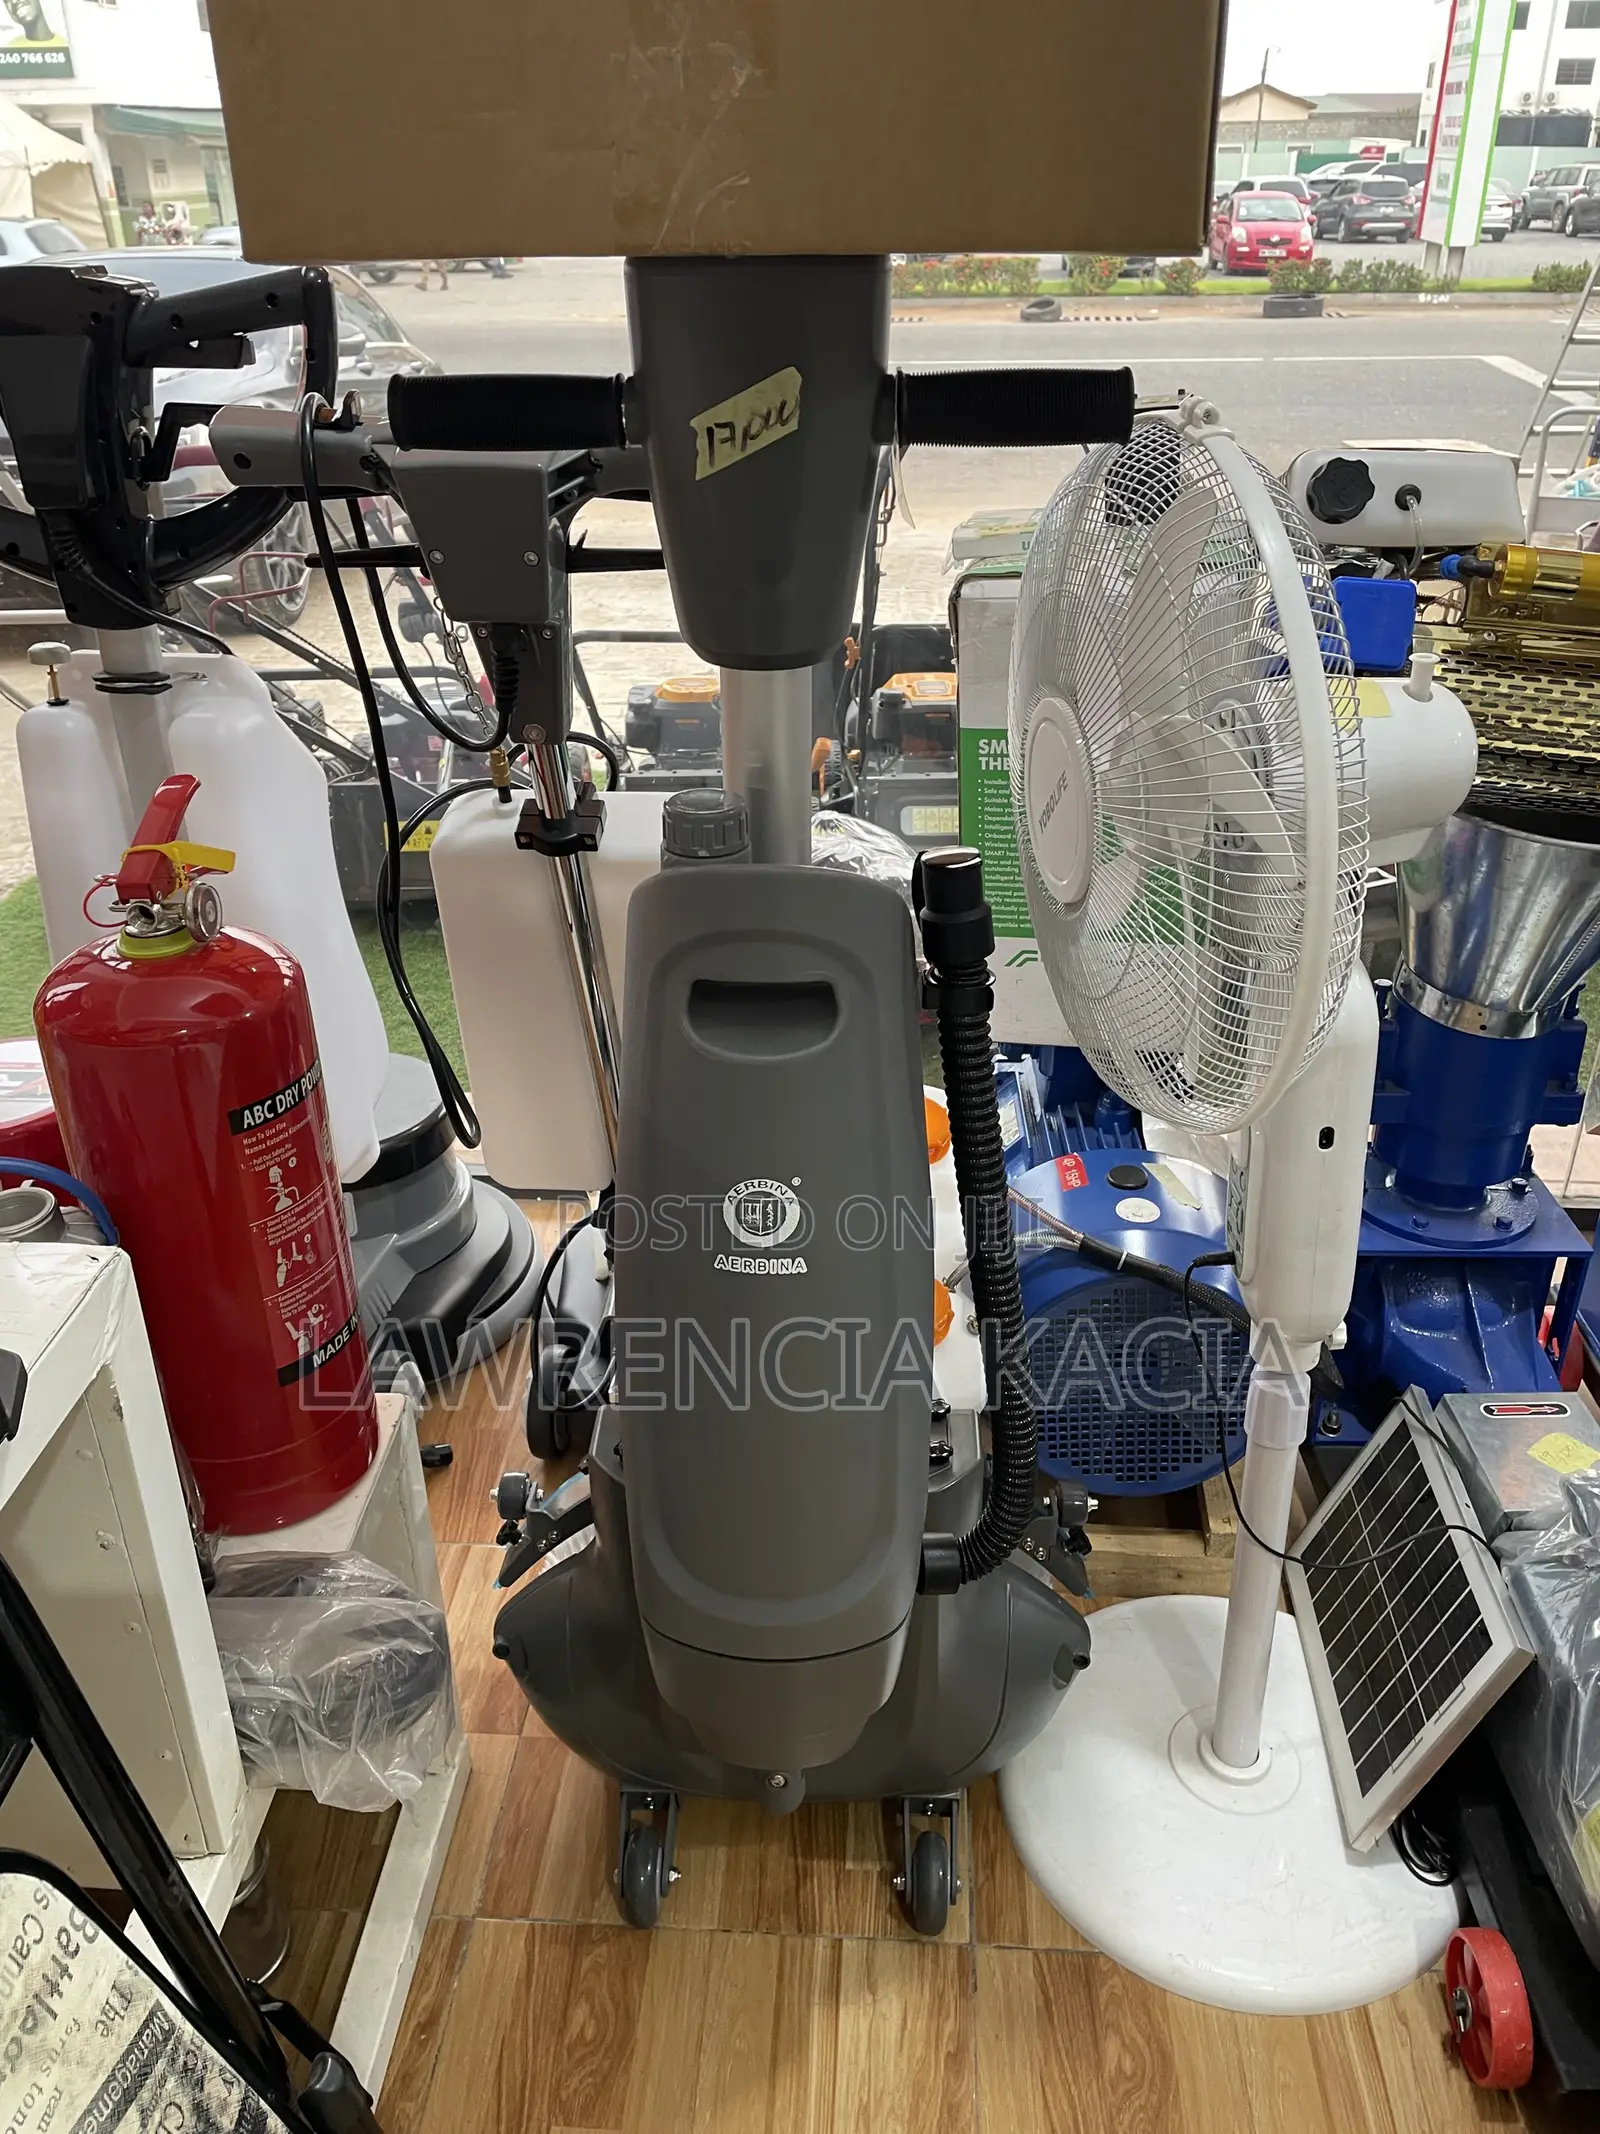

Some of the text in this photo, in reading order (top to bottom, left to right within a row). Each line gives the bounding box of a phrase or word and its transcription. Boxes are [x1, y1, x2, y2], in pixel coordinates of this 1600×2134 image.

[1038, 770, 1069, 834] YOBOLIFE
[243, 1100, 274, 1129] ABC
[275, 1083, 299, 1114] DRY
[265, 1127, 276, 1138] Use
[726, 1179, 796, 1206] AERBINA
[1064, 1169, 1082, 1188] 15HP
[713, 1253, 808, 1275] AERBINA
[312, 1326, 350, 1367] MADE
[77, 2010, 169, 2134] Manageme
